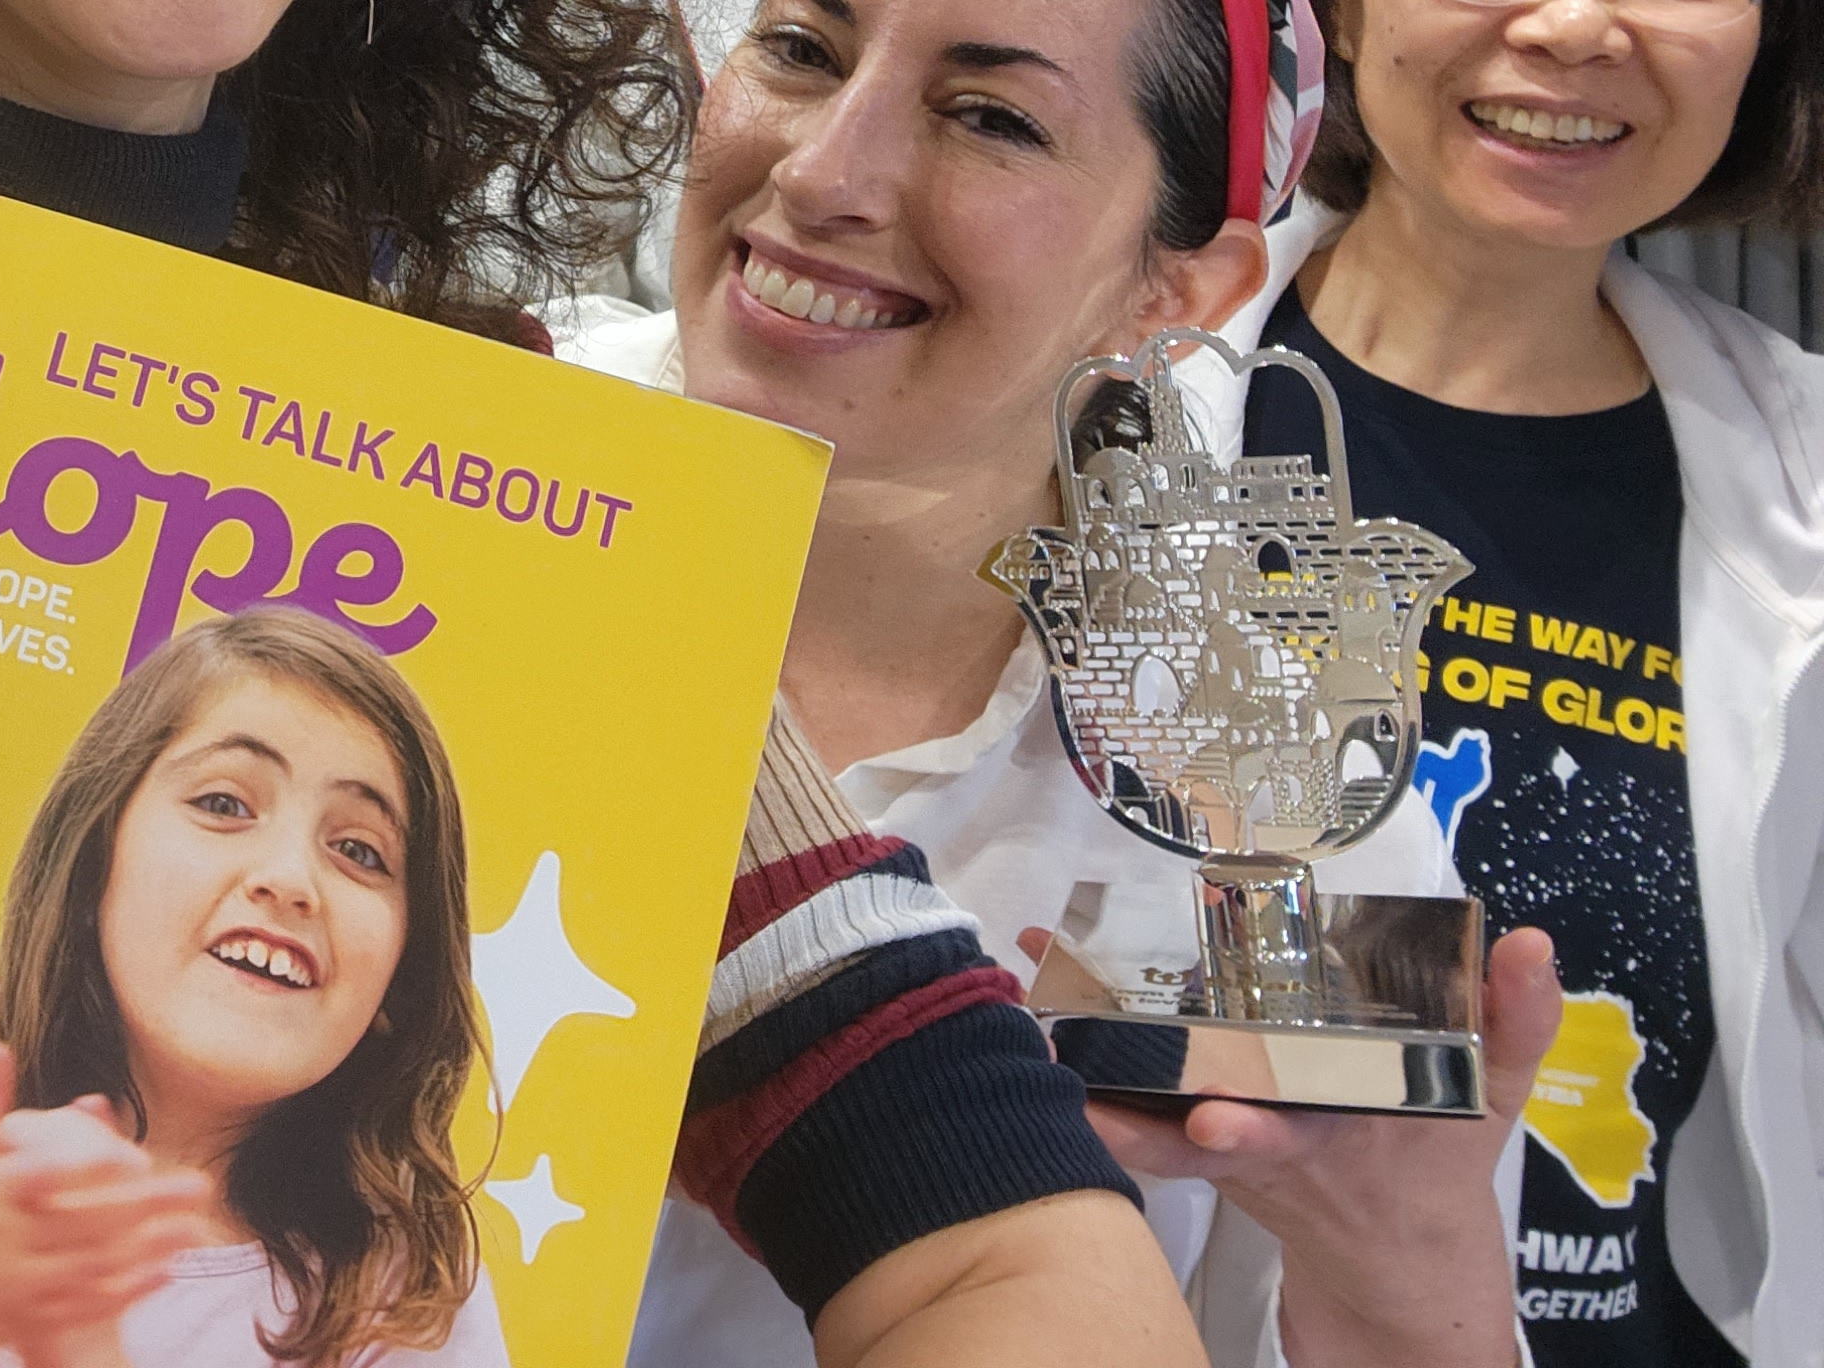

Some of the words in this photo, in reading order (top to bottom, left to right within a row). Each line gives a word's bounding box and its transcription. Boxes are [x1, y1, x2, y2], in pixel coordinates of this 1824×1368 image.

[46, 332, 219, 426] LET'S
[238, 386, 393, 481] TALK
[401, 443, 633, 548] ABOUT
[1529, 613, 1637, 671] WAY
[1643, 643, 1683, 687] F
[1442, 657, 1532, 709] OF
[1541, 679, 1688, 755] GLOR
[1517, 1280, 1638, 1320] GETHER
